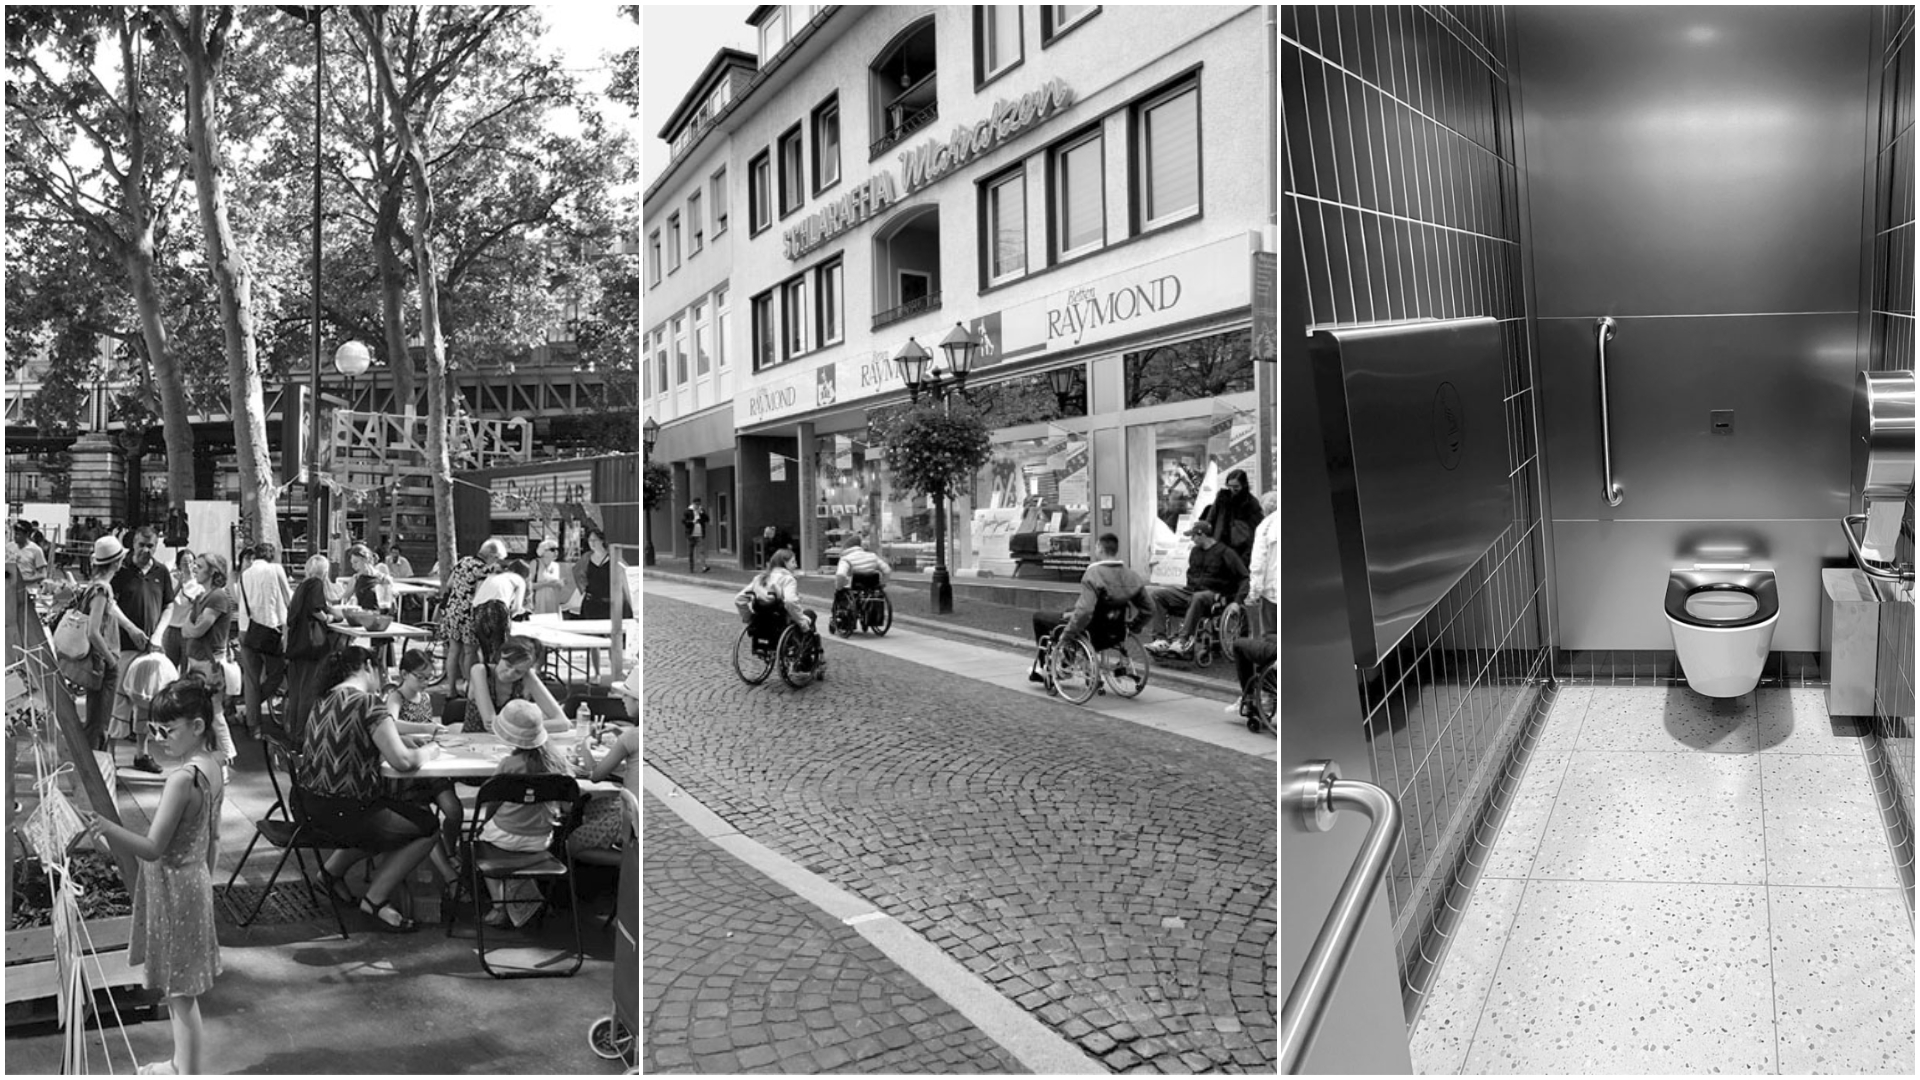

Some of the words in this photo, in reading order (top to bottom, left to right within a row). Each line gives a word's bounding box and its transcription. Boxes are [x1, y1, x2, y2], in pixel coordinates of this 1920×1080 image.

[783, 169, 898, 261] SCHLARAFFIA
[1047, 274, 1182, 345] RAYMOND
[749, 386, 796, 420] RAYMOND
